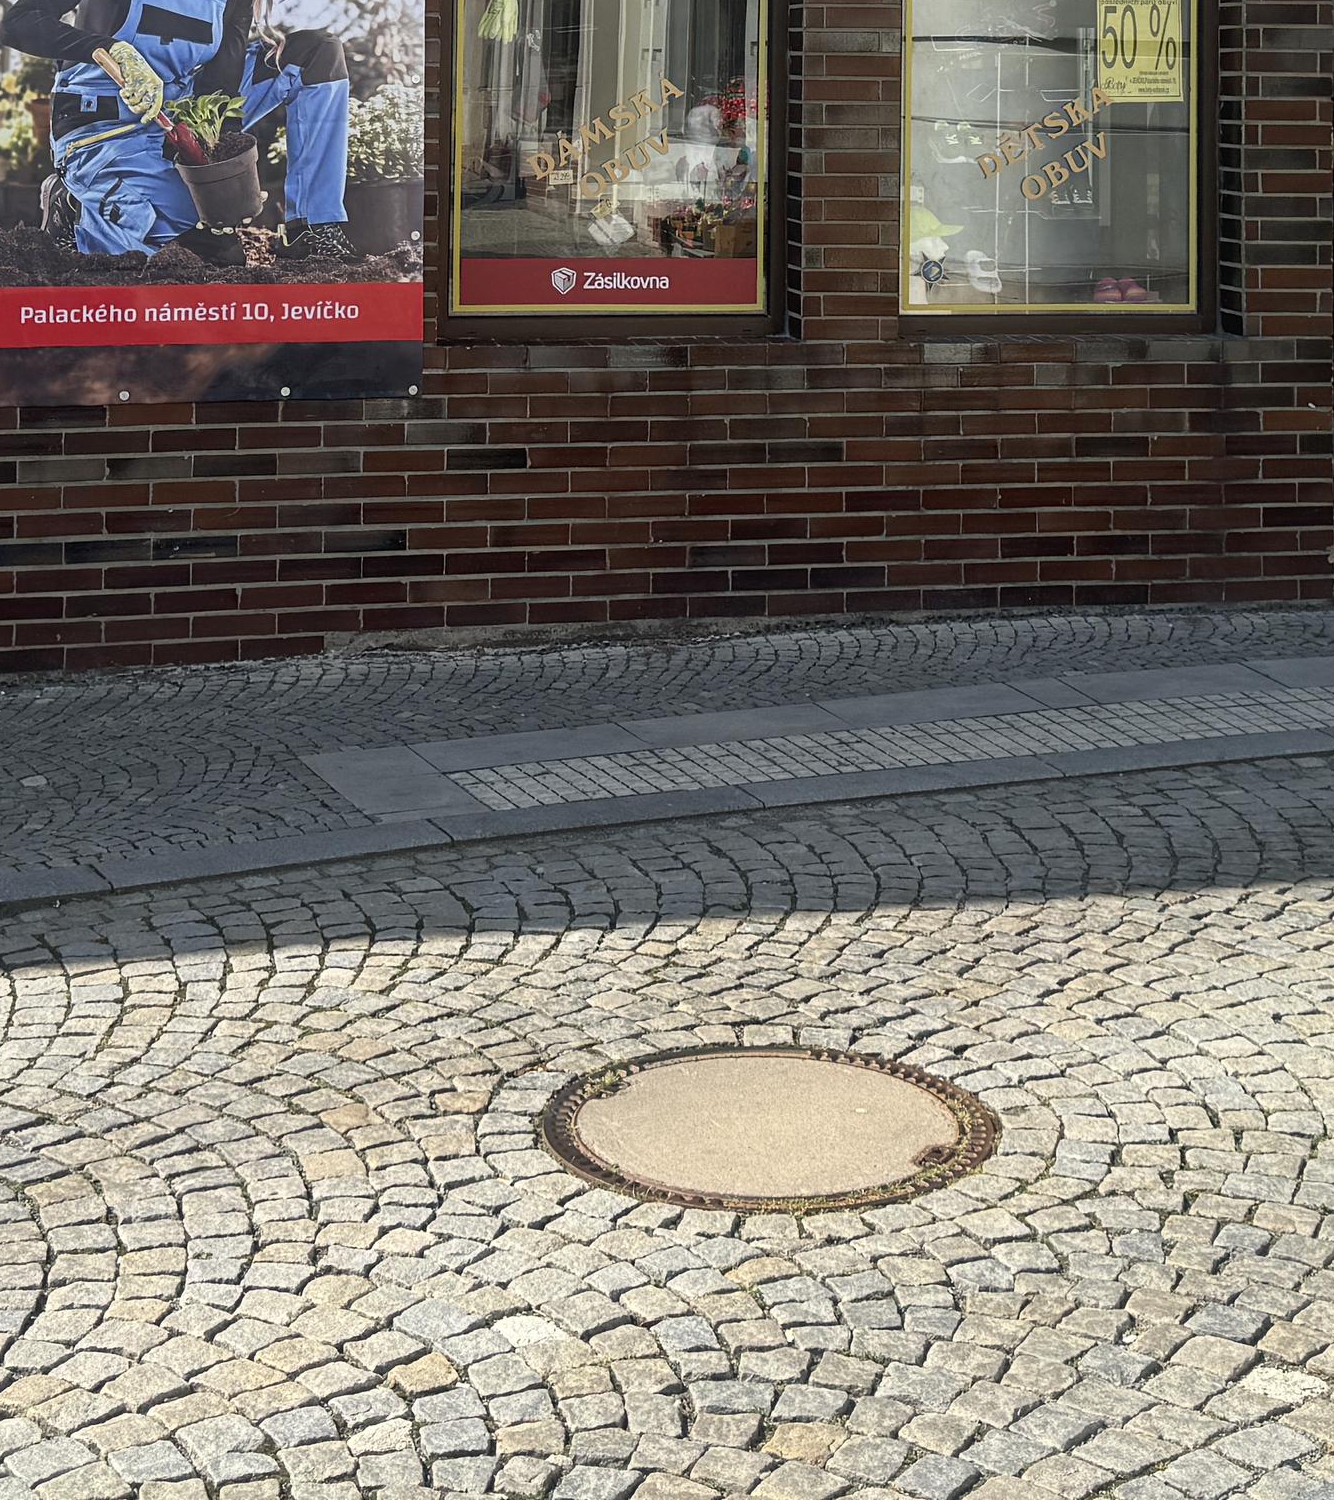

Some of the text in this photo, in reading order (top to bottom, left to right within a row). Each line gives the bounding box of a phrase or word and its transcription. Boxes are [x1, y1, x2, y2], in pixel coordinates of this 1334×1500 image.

[1101, 3, 1177, 71] 50 %
[579, 126, 670, 199] OBUV
[1020, 131, 1106, 200] OBUV
[20, 300, 360, 325] Palackého náměstí 10, Jevíčko
[583, 271, 670, 290] Zásilkovna
